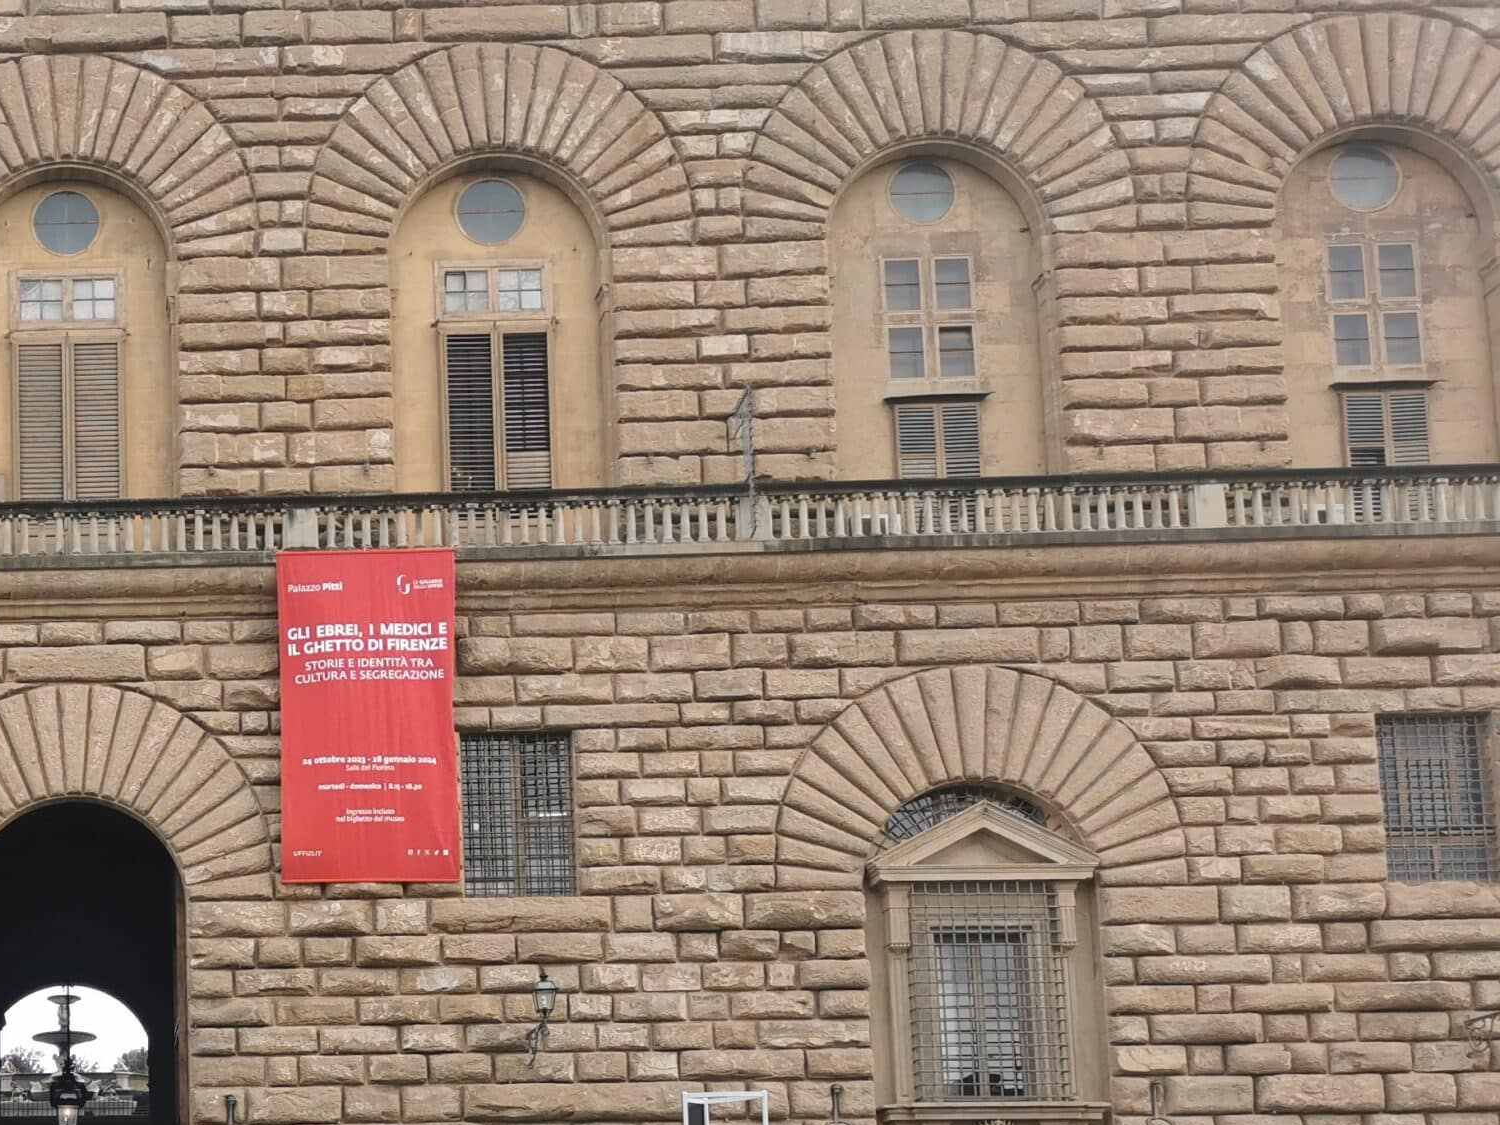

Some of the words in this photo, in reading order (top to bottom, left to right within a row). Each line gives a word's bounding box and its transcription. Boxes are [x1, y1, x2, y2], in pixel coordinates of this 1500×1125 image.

[288, 584, 321, 593] Palazzo
[322, 581, 343, 591] Pitti
[287, 626, 310, 641] GLI
[316, 623, 363, 638] EBREI,
[369, 623, 374, 636] I
[380, 622, 432, 636] MEDICI
[438, 622, 448, 635] E
[288, 643, 301, 657] IL
[303, 639, 364, 655] GHETTO
[368, 639, 383, 651] DI
[387, 637, 448, 651] FIRENZE
[304, 658, 345, 671] STORIE
[348, 658, 355, 668] E
[357, 655, 409, 668] IDENTITÀ
[411, 657, 434, 668] TRA
[294, 670, 348, 685] CULTURA
[350, 670, 357, 680] E
[360, 668, 445, 681] SEGREGAZIONE
[314, 755, 346, 764] ottobre
[346, 756, 366, 765] 2023
[384, 755, 416, 765] gennaio
[417, 756, 437, 765] 2024
